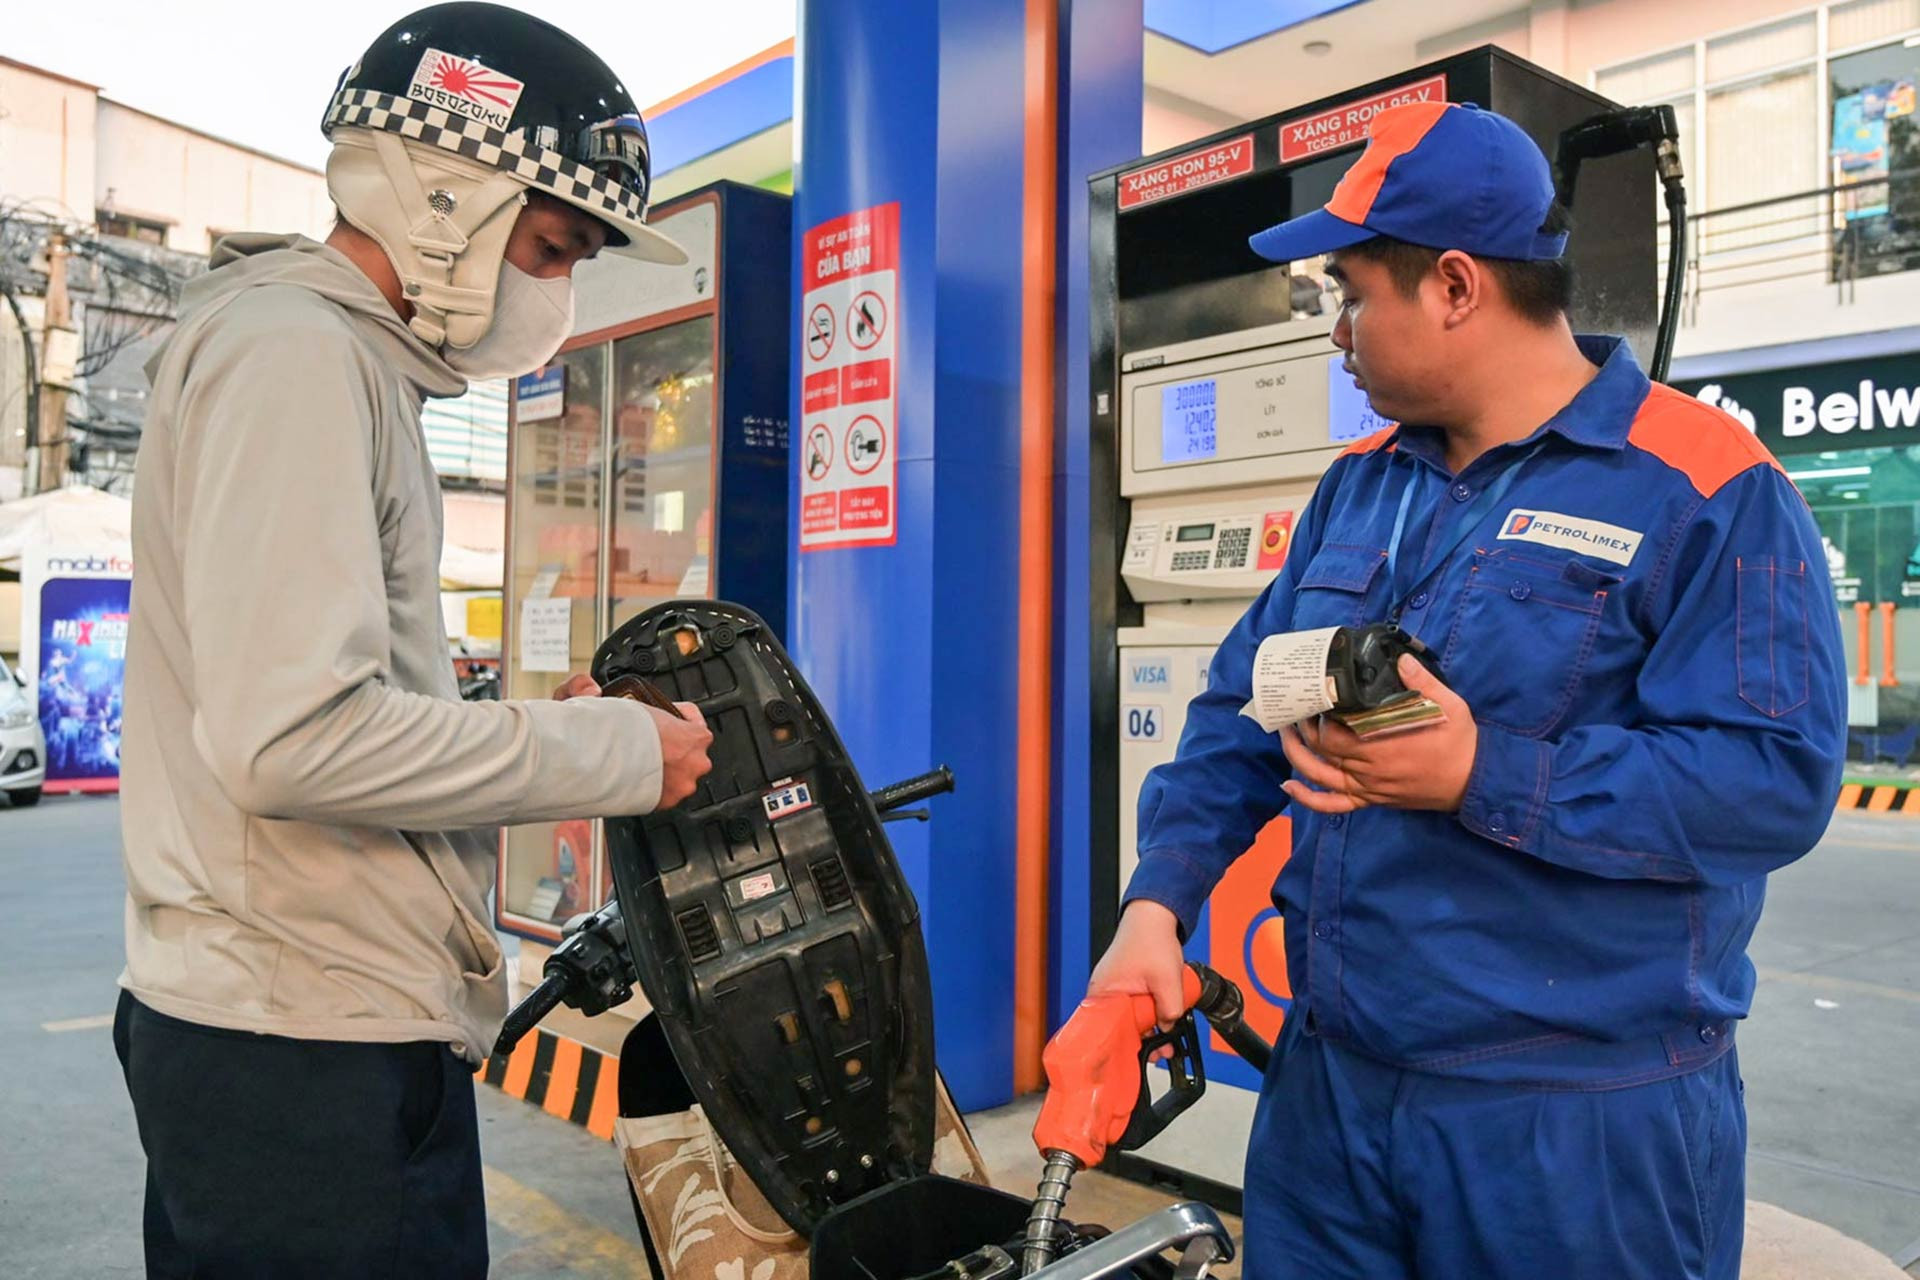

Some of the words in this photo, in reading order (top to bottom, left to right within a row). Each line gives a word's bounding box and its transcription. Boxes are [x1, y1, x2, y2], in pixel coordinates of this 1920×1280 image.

[410, 83, 509, 129] BOSOZOKU
[1293, 116, 1341, 143] XĂNG
[1346, 101, 1386, 126] RON
[1306, 135, 1337, 152] TCCS
[1339, 129, 1351, 142] 01
[1128, 169, 1169, 193] XĂNG
[1172, 159, 1205, 179] RON
[1208, 146, 1242, 168] 95-V
[1139, 182, 1165, 201] TCCS
[1166, 182, 1178, 194] 01
[1185, 166, 1230, 188] 2023/PLX
[817, 250, 840, 279] CỦA
[1532, 521, 1632, 552] PETROLIMEX
[1132, 666, 1167, 683] VISA
[1129, 709, 1156, 737] 06
